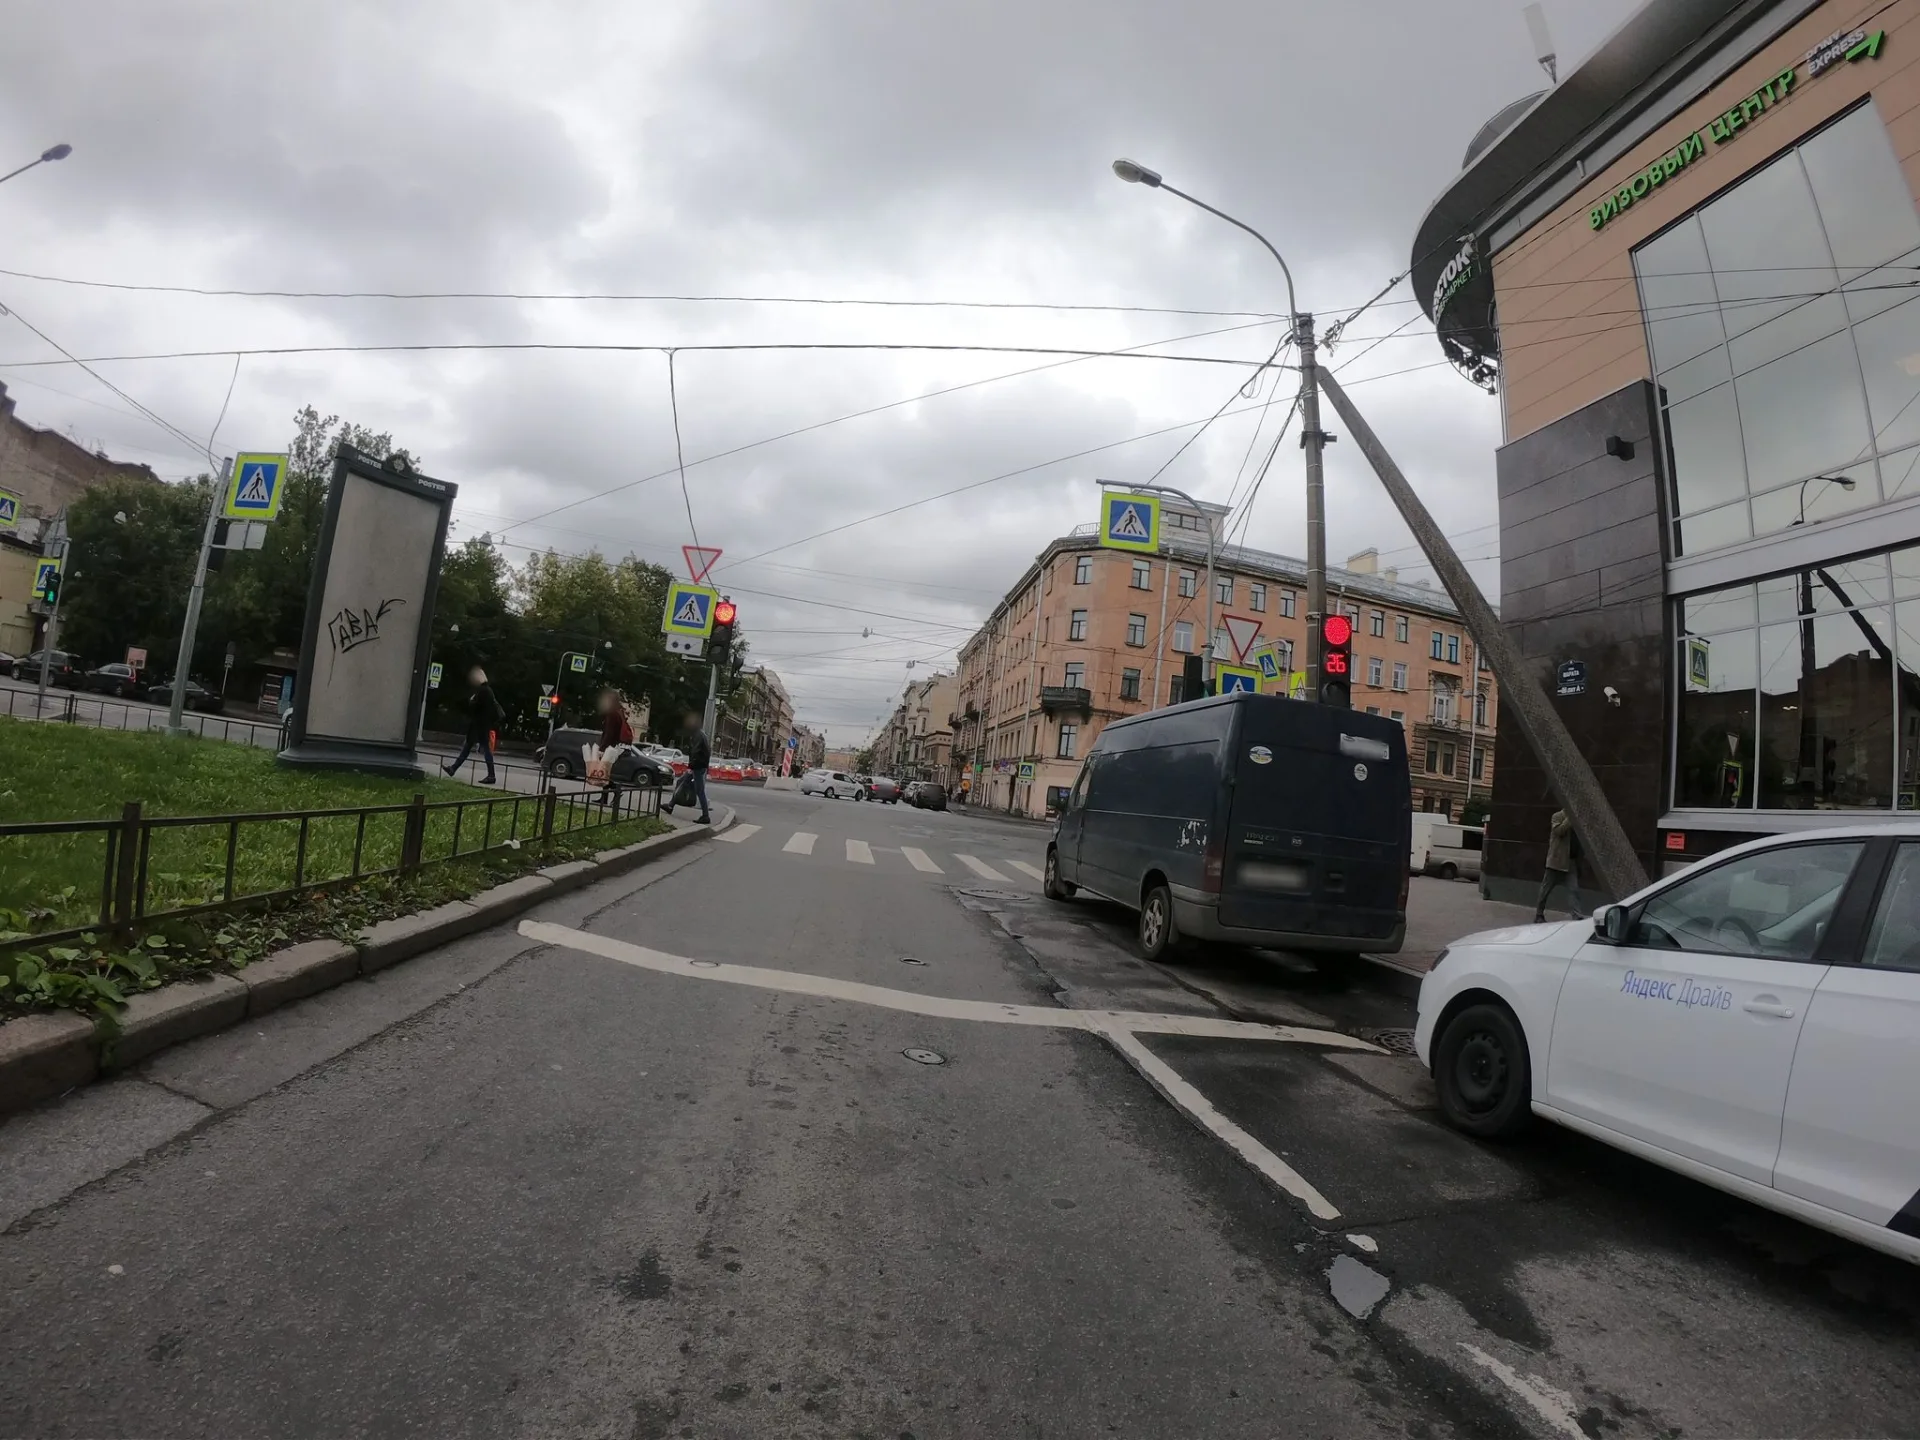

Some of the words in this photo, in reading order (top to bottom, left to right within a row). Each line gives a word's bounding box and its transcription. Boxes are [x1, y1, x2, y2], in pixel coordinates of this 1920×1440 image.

[1806, 28, 1866, 76] EXPRESS
[1589, 131, 1704, 230] ВИЗОВЫЙ
[1708, 67, 1795, 144] ЦЕНТР
[358, 454, 382, 469] POSTER
[418, 478, 446, 492] POSTER
[1326, 654, 1347, 673] 26
[1620, 970, 1676, 1000] Яндекс
[1676, 978, 1733, 1010] Драйв
